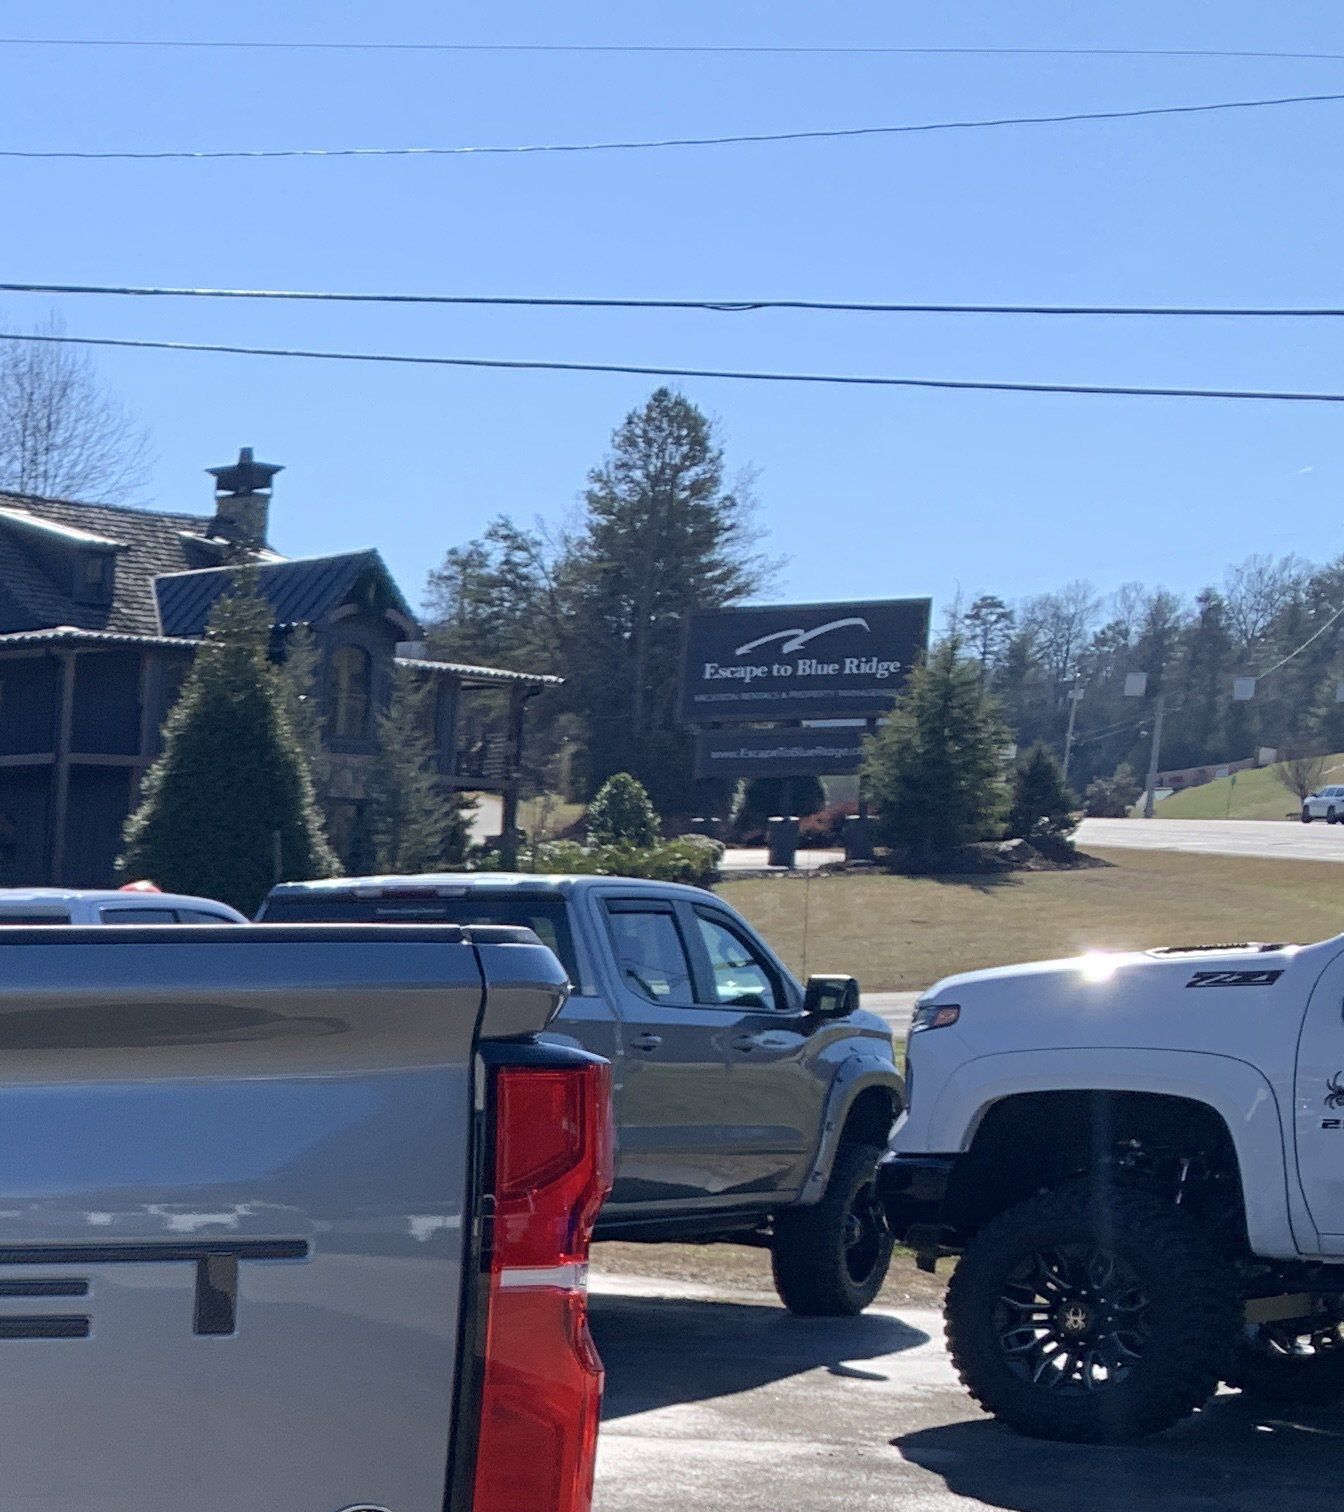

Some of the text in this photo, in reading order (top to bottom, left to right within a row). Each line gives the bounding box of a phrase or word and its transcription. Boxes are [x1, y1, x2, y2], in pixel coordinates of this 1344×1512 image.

[702, 656, 901, 683] Escape to Blue Ridge
